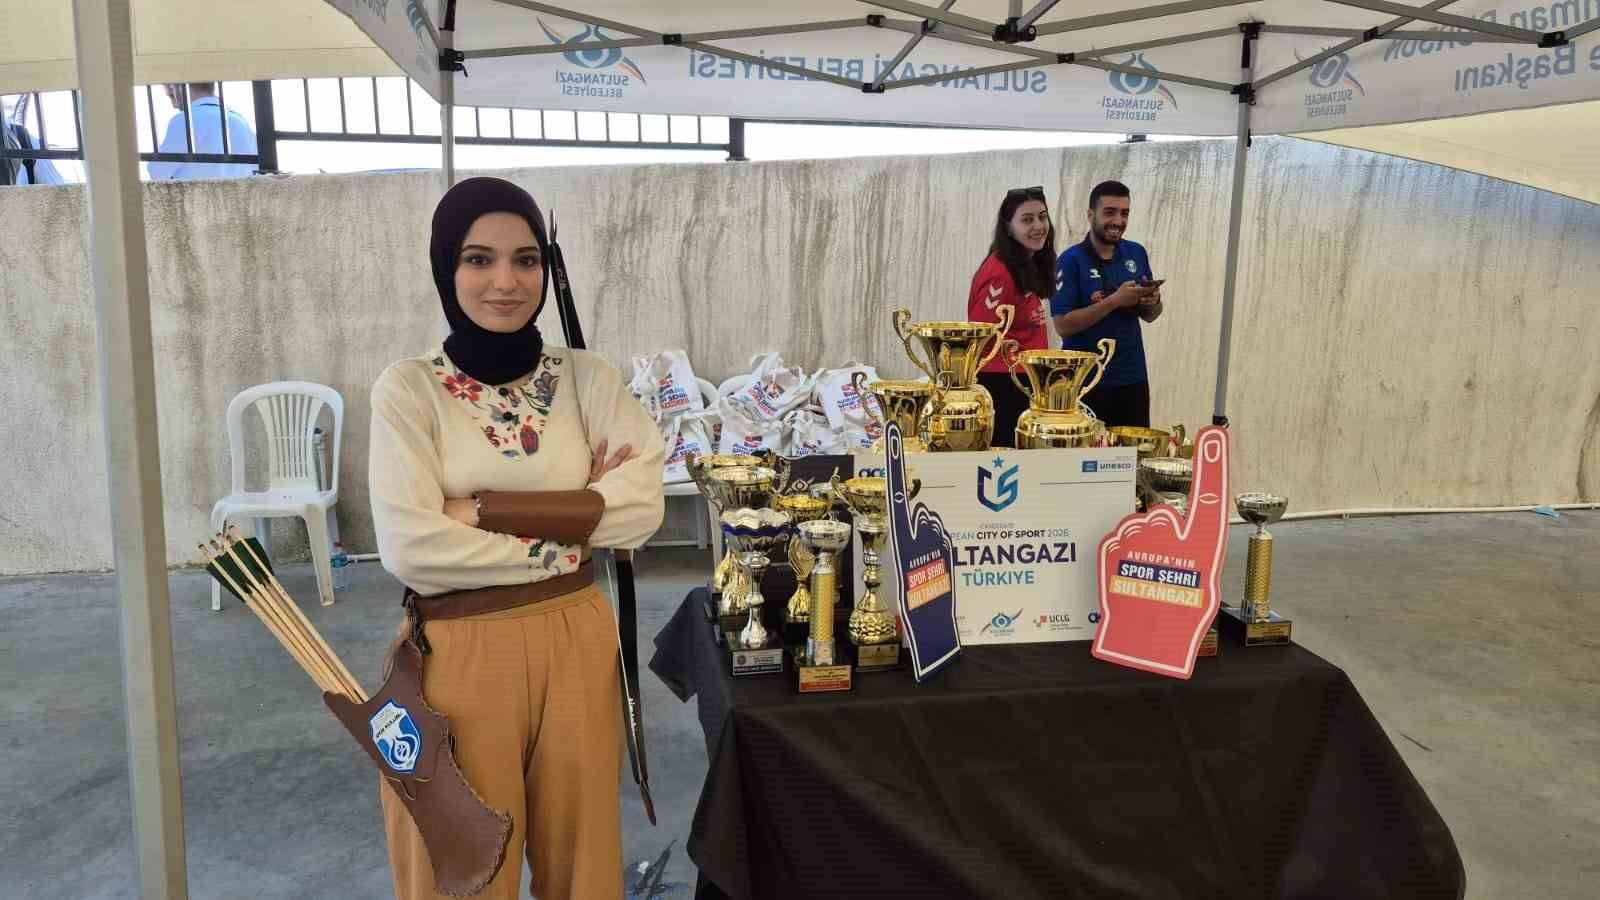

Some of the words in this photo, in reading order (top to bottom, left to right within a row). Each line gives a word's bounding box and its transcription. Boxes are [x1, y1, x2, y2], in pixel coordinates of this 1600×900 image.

[950, 532, 975, 541] PEAN
[976, 531, 999, 541] CITY
[1000, 530, 1014, 539] OF
[1015, 529, 1046, 539] SPORT
[953, 542, 1077, 567] LTANGAZI
[1127, 550, 1196, 570] AVRUPA'NIN
[909, 570, 927, 588] SPOR
[1120, 563, 1155, 580] SPOR
[1158, 568, 1198, 587] ŞEHRİ
